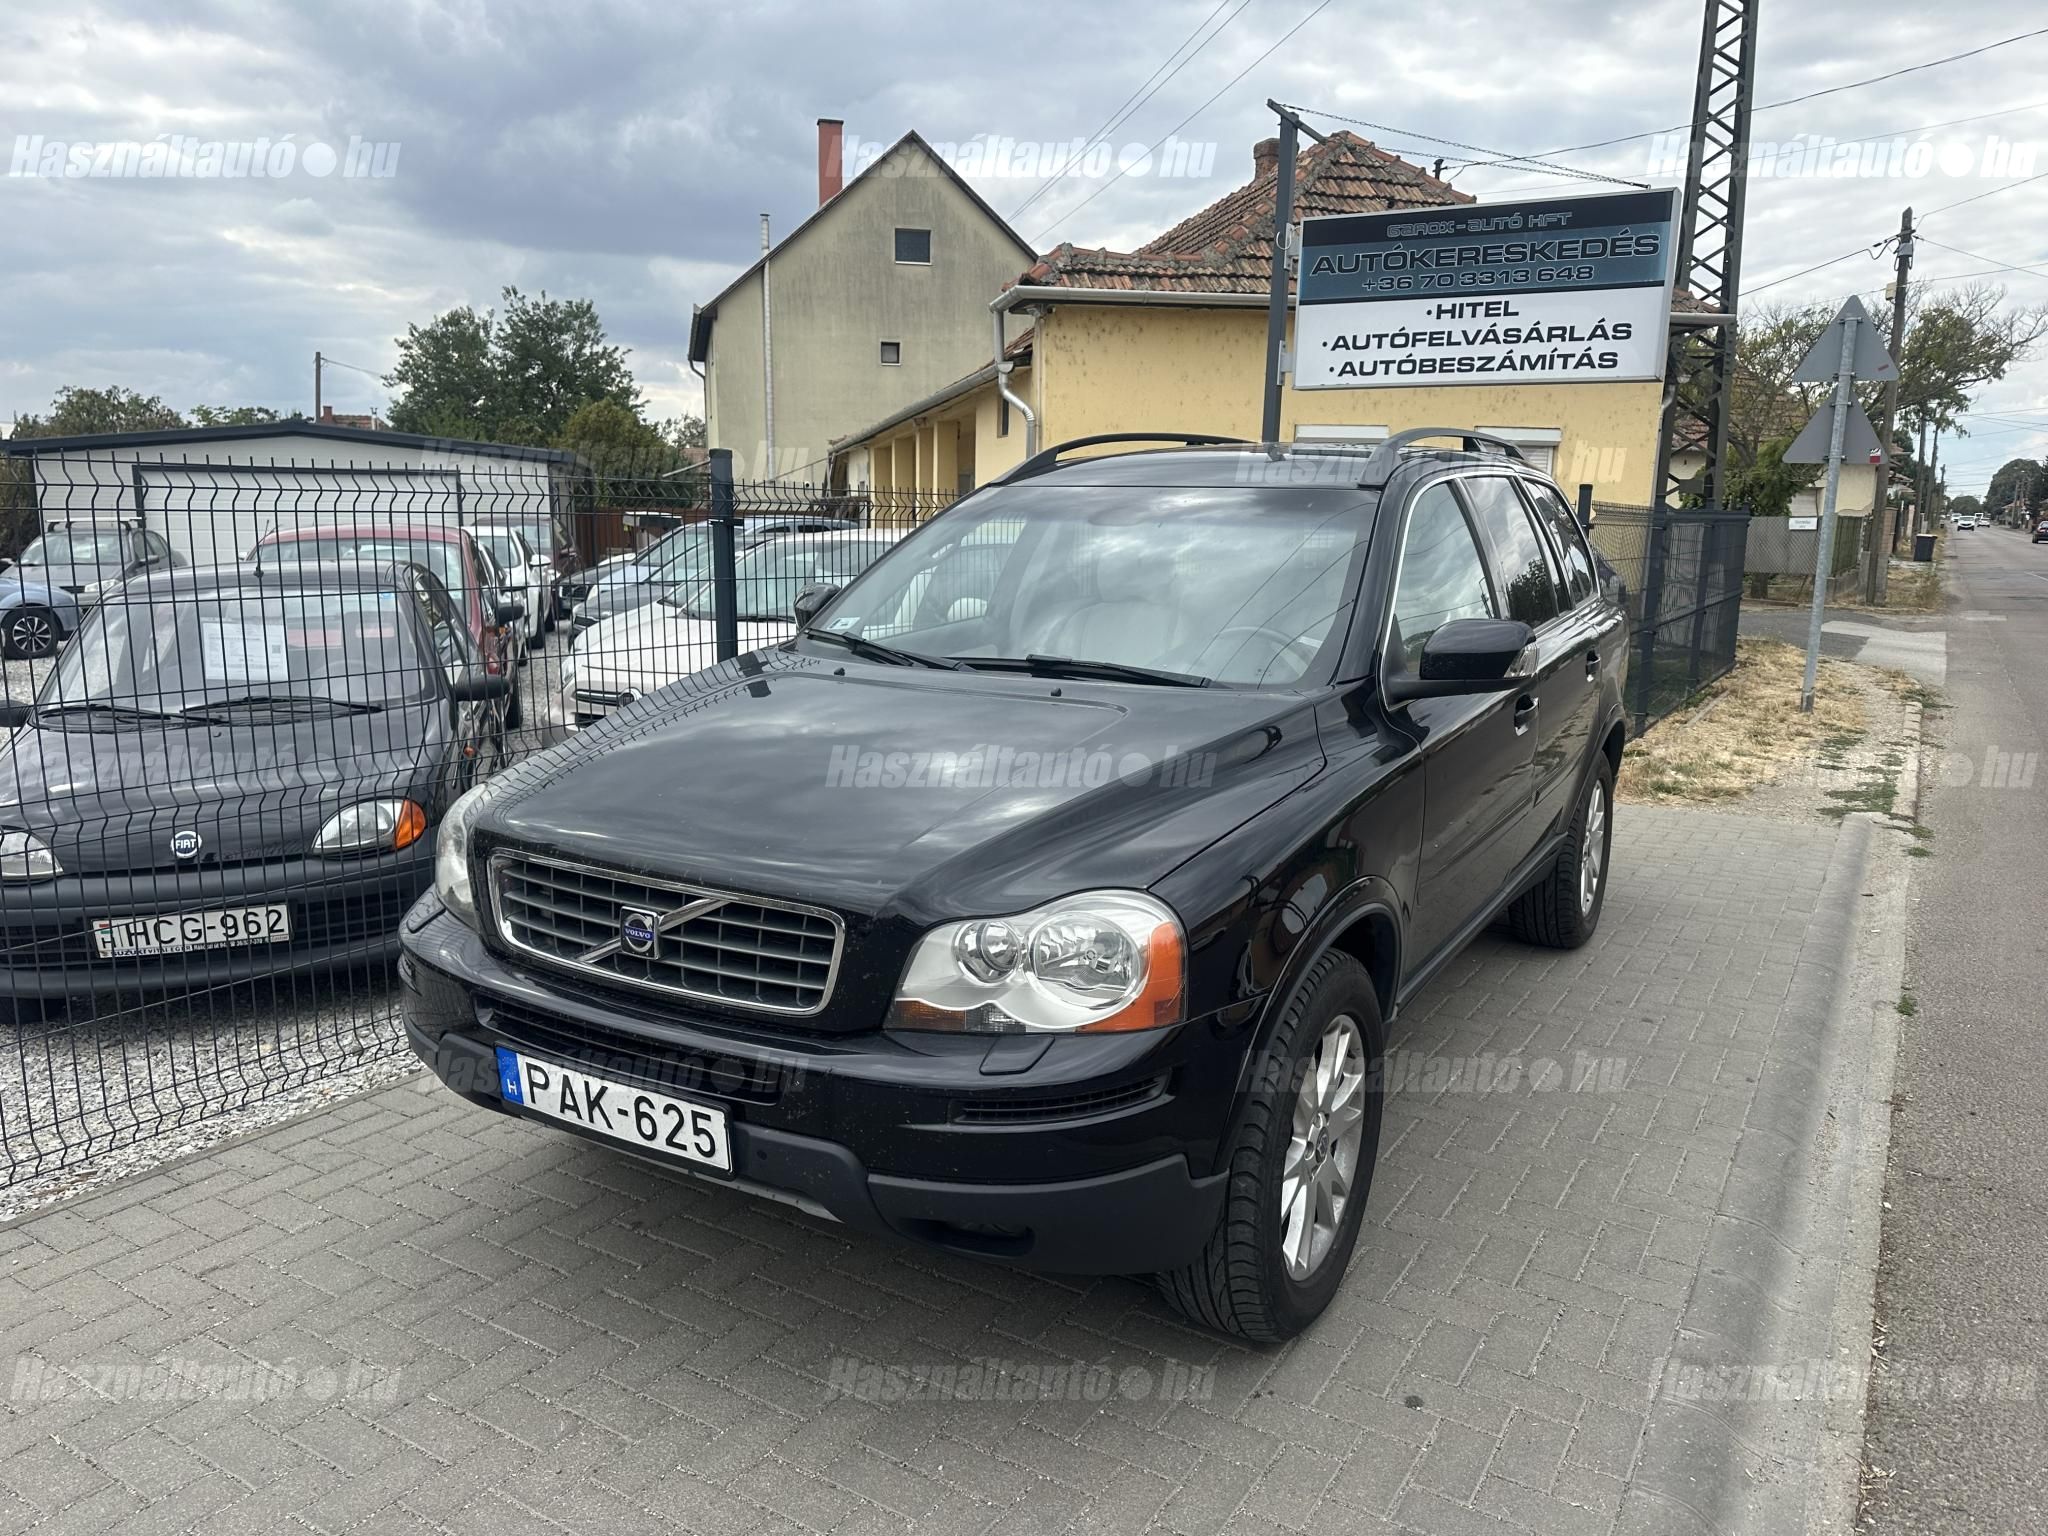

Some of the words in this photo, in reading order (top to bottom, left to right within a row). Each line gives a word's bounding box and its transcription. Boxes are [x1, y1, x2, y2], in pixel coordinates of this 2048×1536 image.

[1310, 227, 1661, 276] AUTÓKERESKEDÉS
[1362, 276, 1412, 291] +36
[1421, 273, 1455, 289] 70
[1459, 269, 1531, 286] 3313
[1536, 265, 1594, 282] 648
[175, 838, 197, 849] FIAT
[125, 909, 285, 947] HCG-962
[625, 929, 651, 939] VOLVO
[525, 1062, 716, 1158] PAK-625
